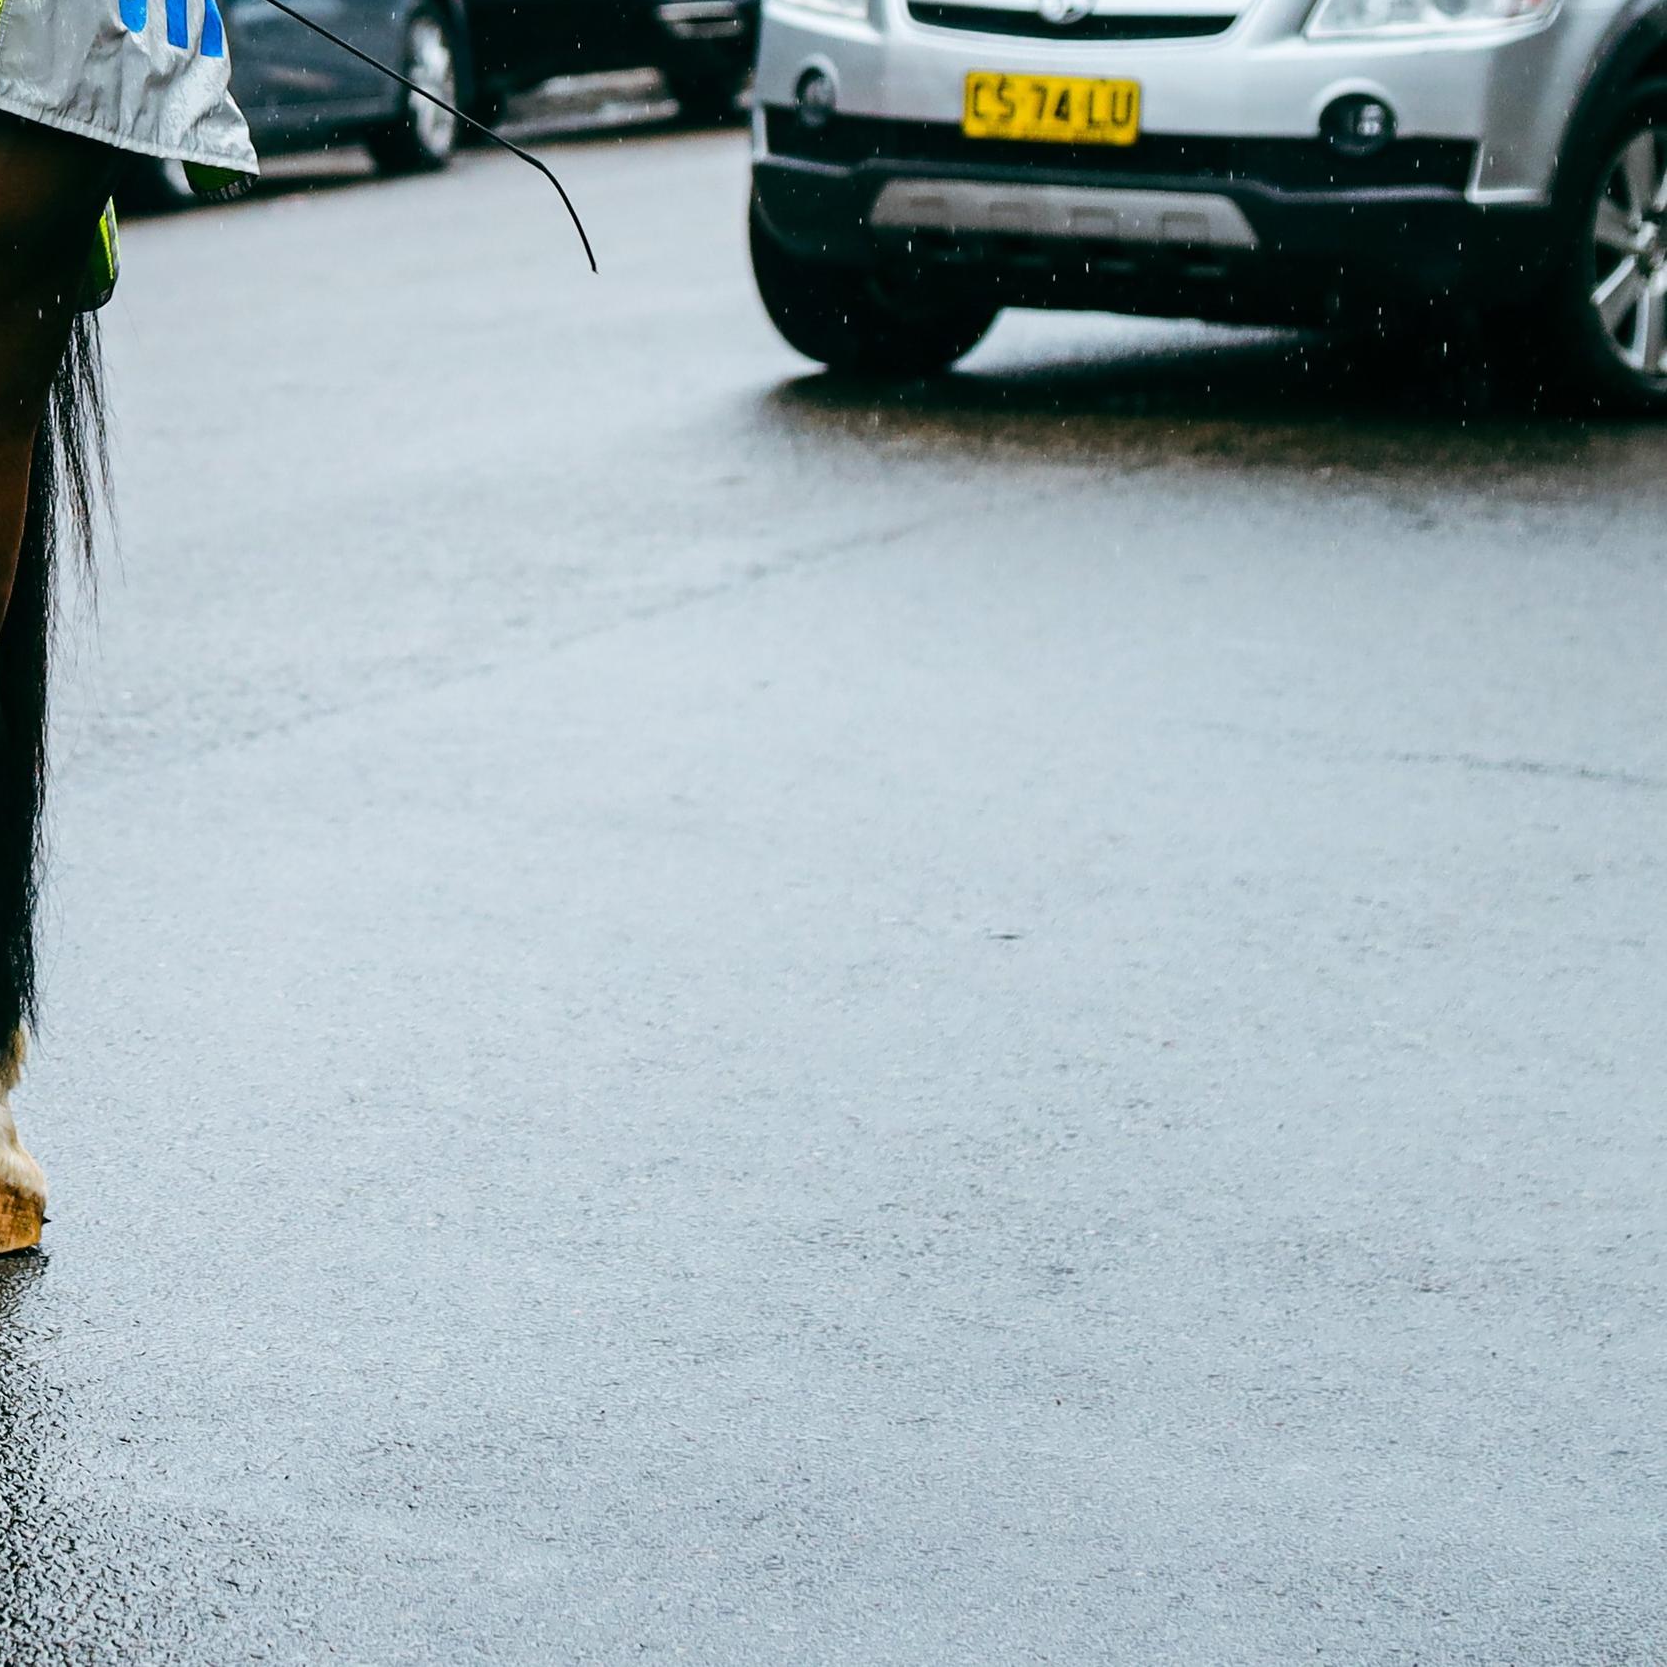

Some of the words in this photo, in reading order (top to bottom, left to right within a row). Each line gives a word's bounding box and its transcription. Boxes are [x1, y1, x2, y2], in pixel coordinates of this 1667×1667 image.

[973, 75, 1016, 122] CS
[1031, 84, 1070, 122] 74
[1088, 88, 1133, 129] LU
